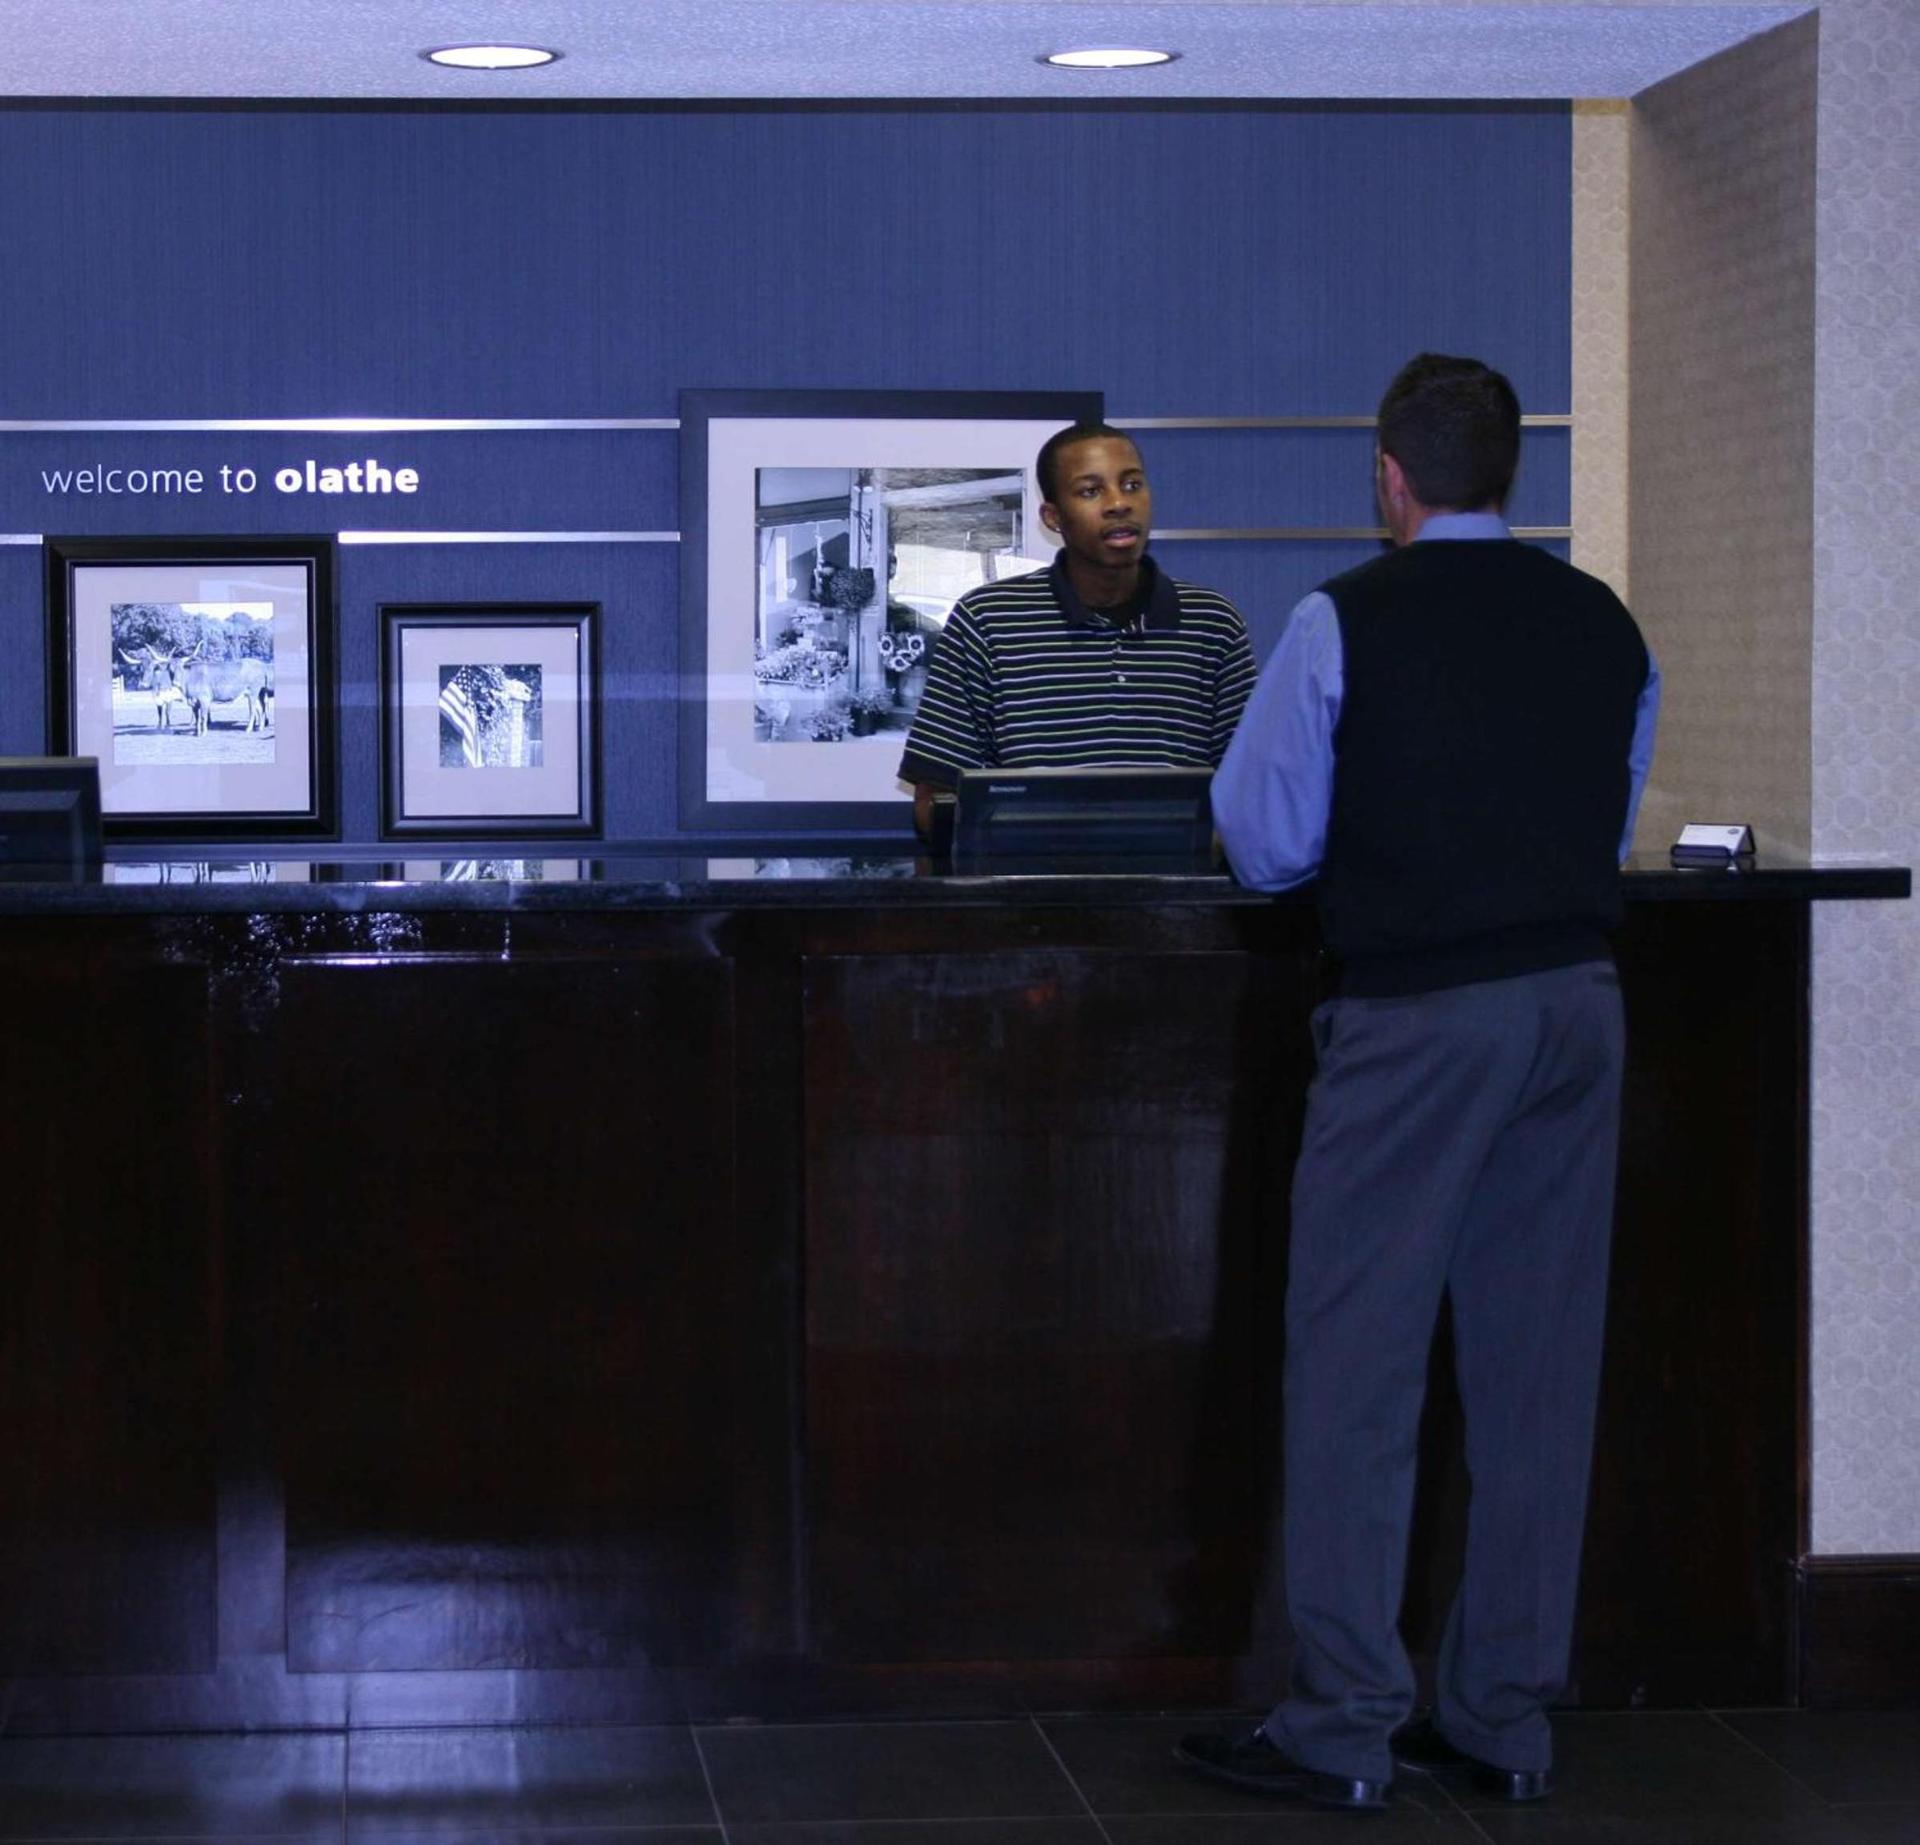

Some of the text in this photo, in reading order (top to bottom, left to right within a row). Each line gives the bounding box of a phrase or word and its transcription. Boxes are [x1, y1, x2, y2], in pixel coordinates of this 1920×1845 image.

[41, 458, 420, 494] welcome to olathe
